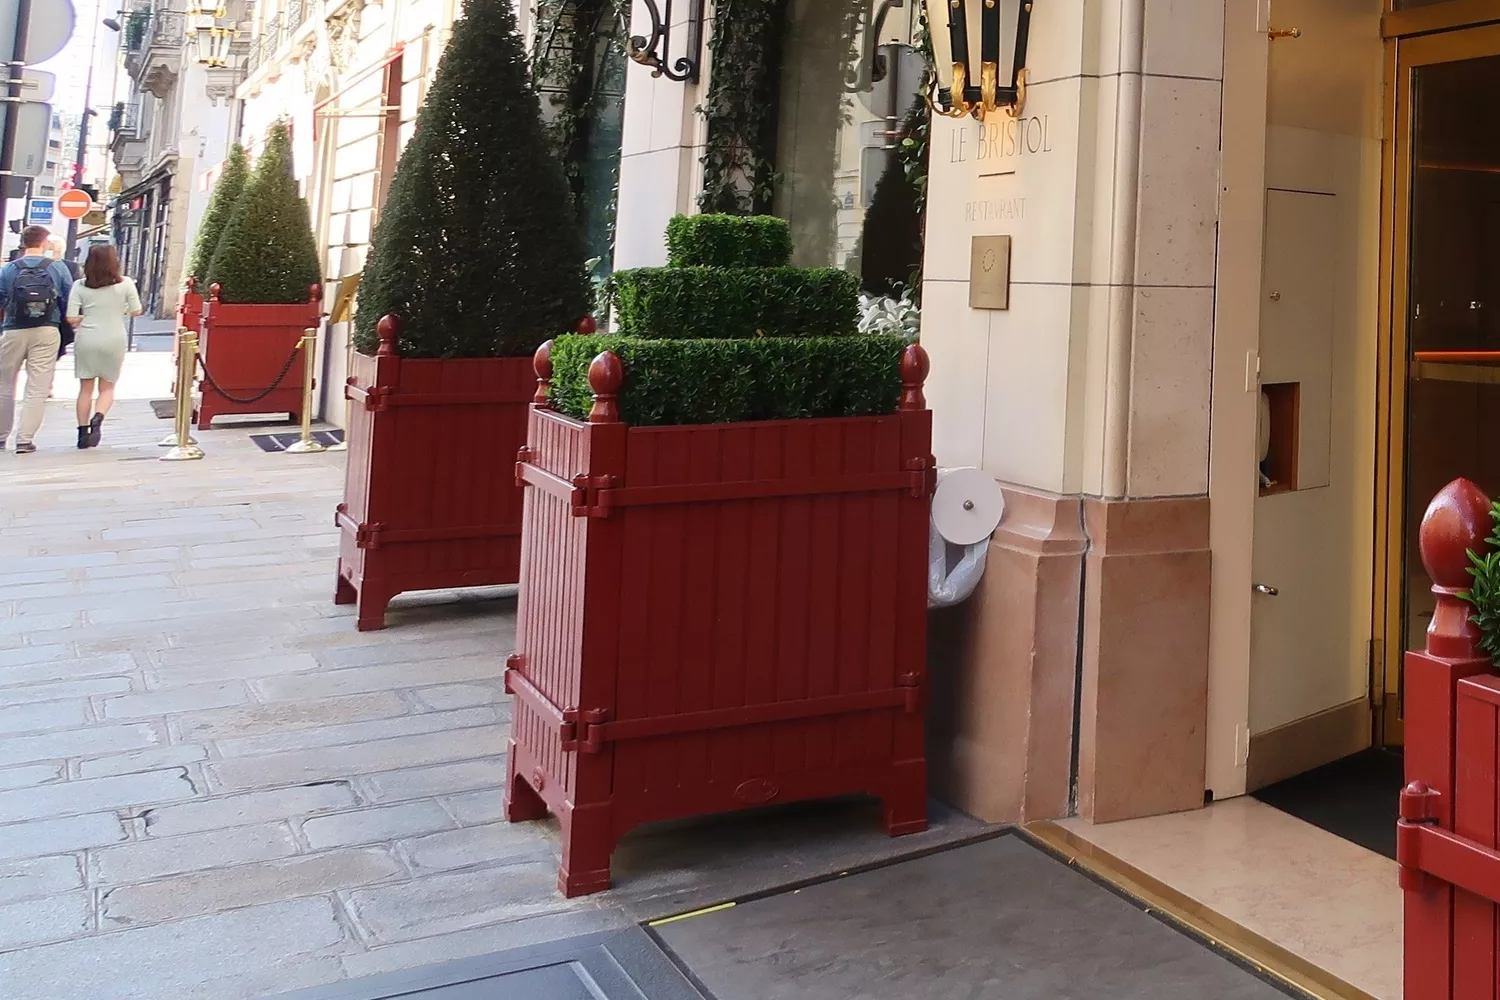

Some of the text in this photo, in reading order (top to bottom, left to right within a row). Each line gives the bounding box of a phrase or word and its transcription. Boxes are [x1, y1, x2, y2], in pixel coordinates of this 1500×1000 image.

[951, 115, 1052, 163] LE BRISTOL
[30, 206, 53, 214] TAXIS
